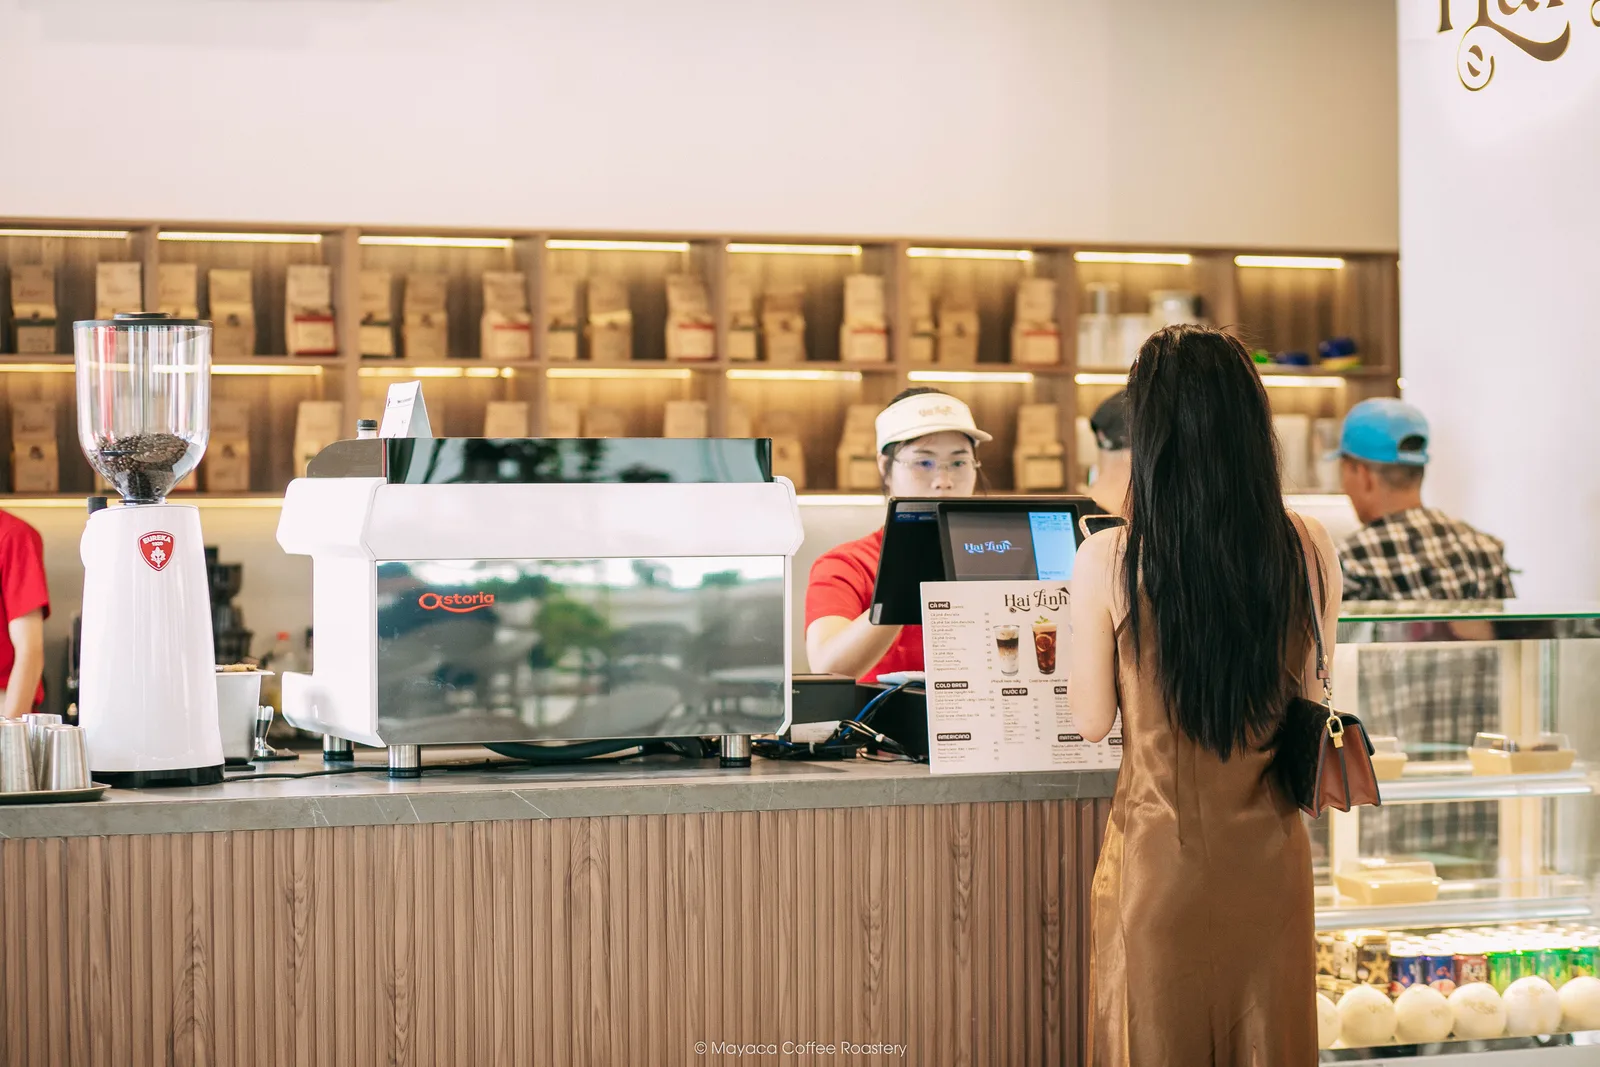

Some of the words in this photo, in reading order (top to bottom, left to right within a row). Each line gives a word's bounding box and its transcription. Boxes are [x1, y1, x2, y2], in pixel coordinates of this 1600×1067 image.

[142, 534, 171, 544] EUREKA
[1004, 594, 1031, 613] Hai
[1033, 587, 1070, 611] Linh
